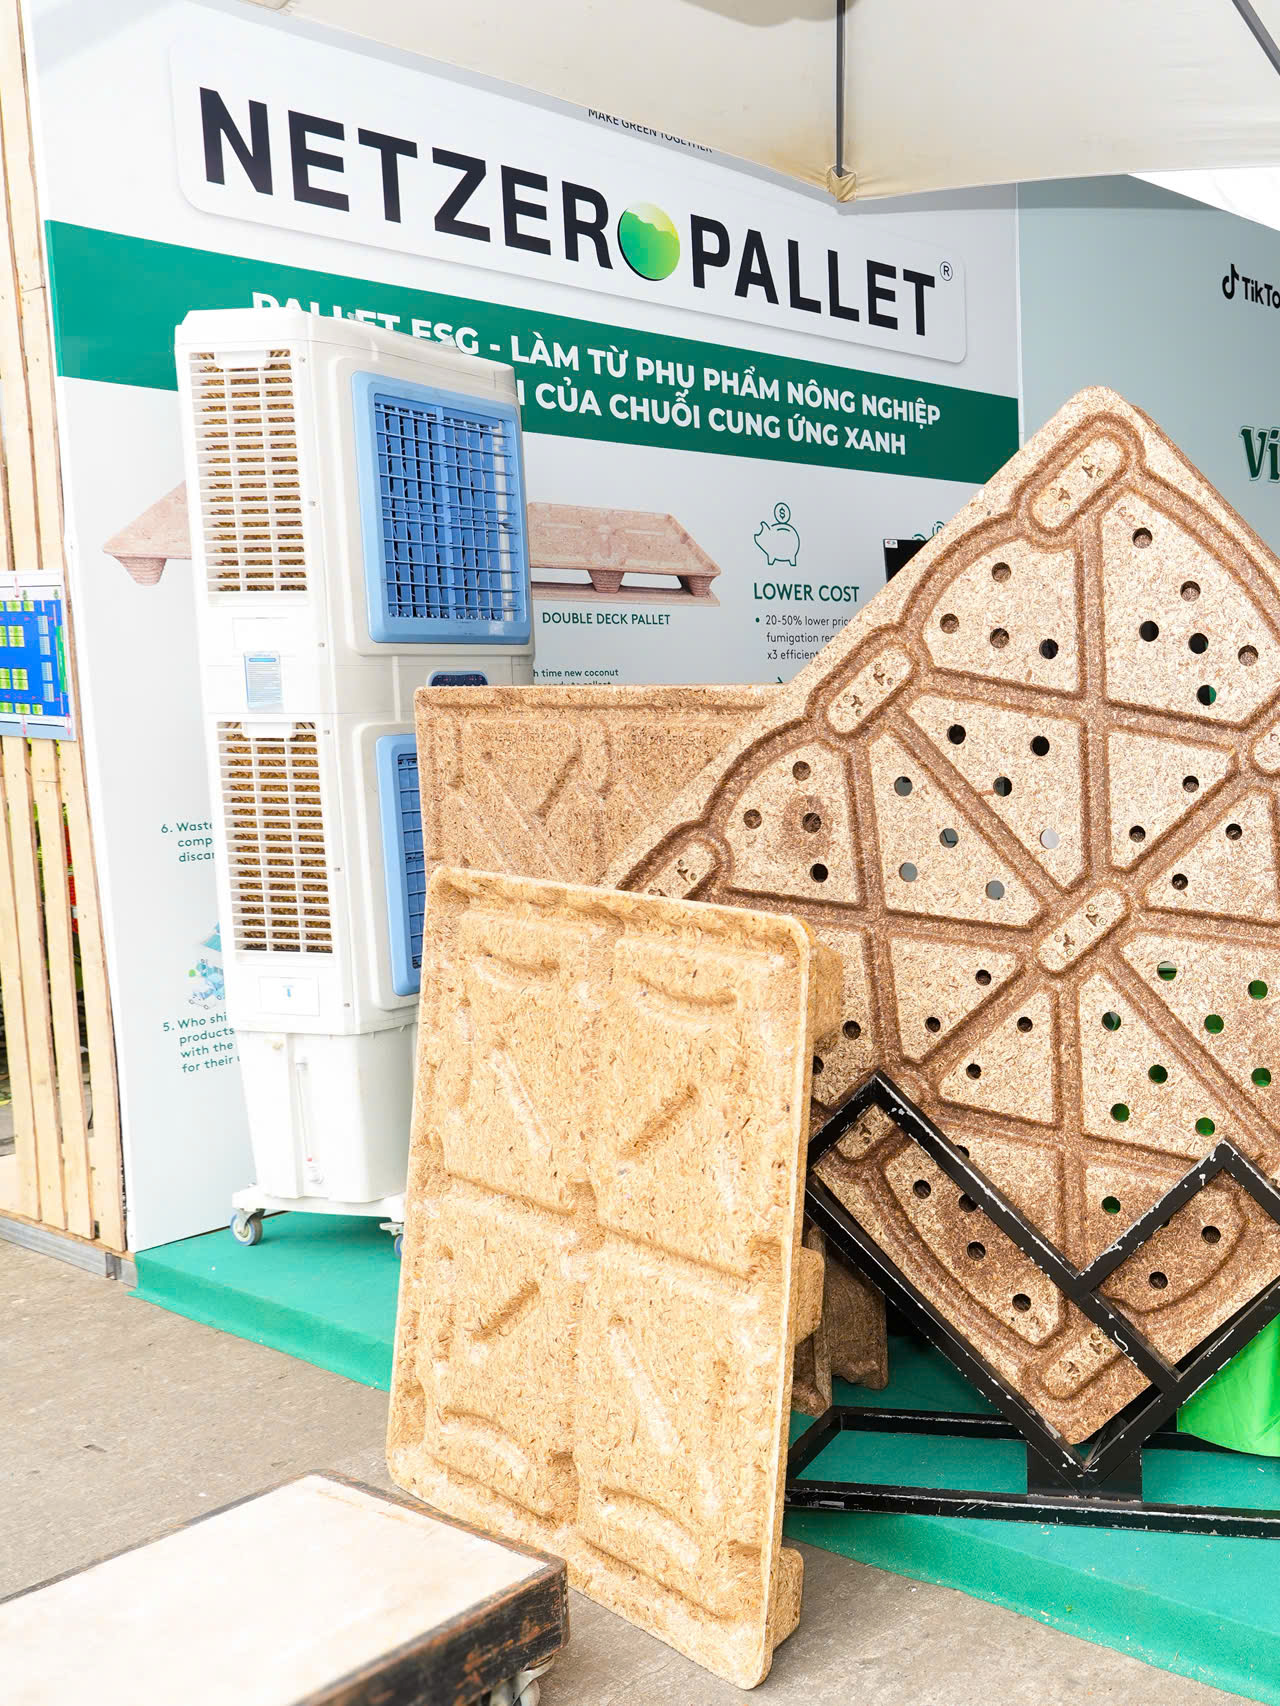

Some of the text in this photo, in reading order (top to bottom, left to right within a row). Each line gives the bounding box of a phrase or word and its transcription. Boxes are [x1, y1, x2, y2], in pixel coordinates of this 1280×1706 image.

[511, 332, 580, 373] LÀM
[587, 344, 630, 379] TỪ
[636, 356, 696, 391] PHỤ
[703, 364, 781, 403] PHẨM
[787, 377, 856, 415] NÔNG
[862, 396, 942, 428] NGHIỆP
[535, 376, 602, 417] CỦA
[611, 390, 700, 431] CHUỖI
[709, 408, 782, 440] CUNG
[787, 410, 838, 448] ỨNG
[845, 428, 906, 456] XANH
[753, 582, 860, 603] LOWER COST
[542, 611, 671, 626] DOUBLE DECK PALLET
[765, 614, 802, 627] 20-50%
[805, 615, 829, 626] lower
[766, 631, 819, 645] fumigation
[767, 649, 778, 660] x3
[541, 668, 562, 678] time
[564, 669, 582, 678] new
[584, 669, 619, 678] coconut
[178, 1018, 206, 1031] Who
[179, 1027, 235, 1048] products
[180, 1041, 234, 1059] with the
[182, 1059, 201, 1073] for
[204, 1054, 234, 1069] their
